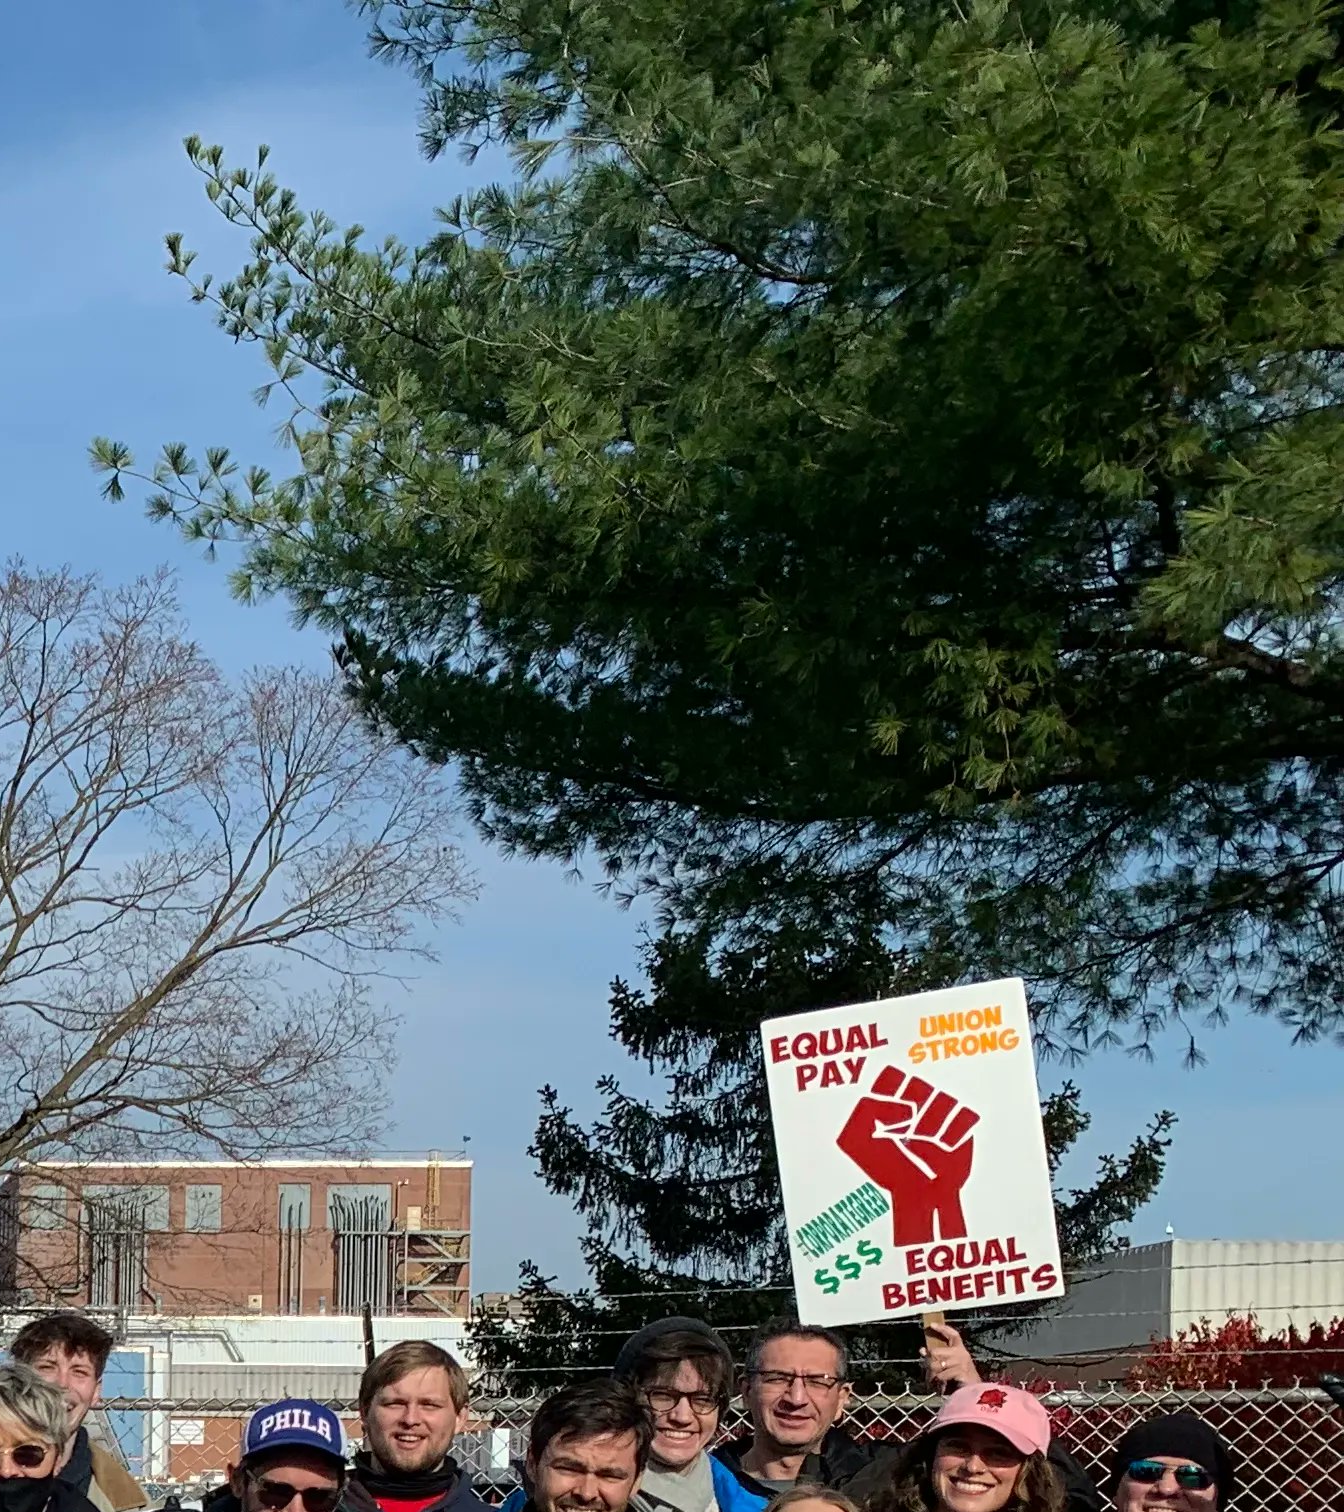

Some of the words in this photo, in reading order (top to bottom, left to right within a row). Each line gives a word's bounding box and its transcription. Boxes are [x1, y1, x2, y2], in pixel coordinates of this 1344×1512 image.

[919, 1004, 1002, 1038] UNION
[770, 1023, 889, 1064] EQUAL
[908, 1028, 1020, 1064] STRONG
[796, 1056, 867, 1092] PAY
[905, 1236, 1027, 1276] EQUAL
[882, 1263, 1058, 1310] BENEFITS
[260, 1408, 332, 1443] PHILA
